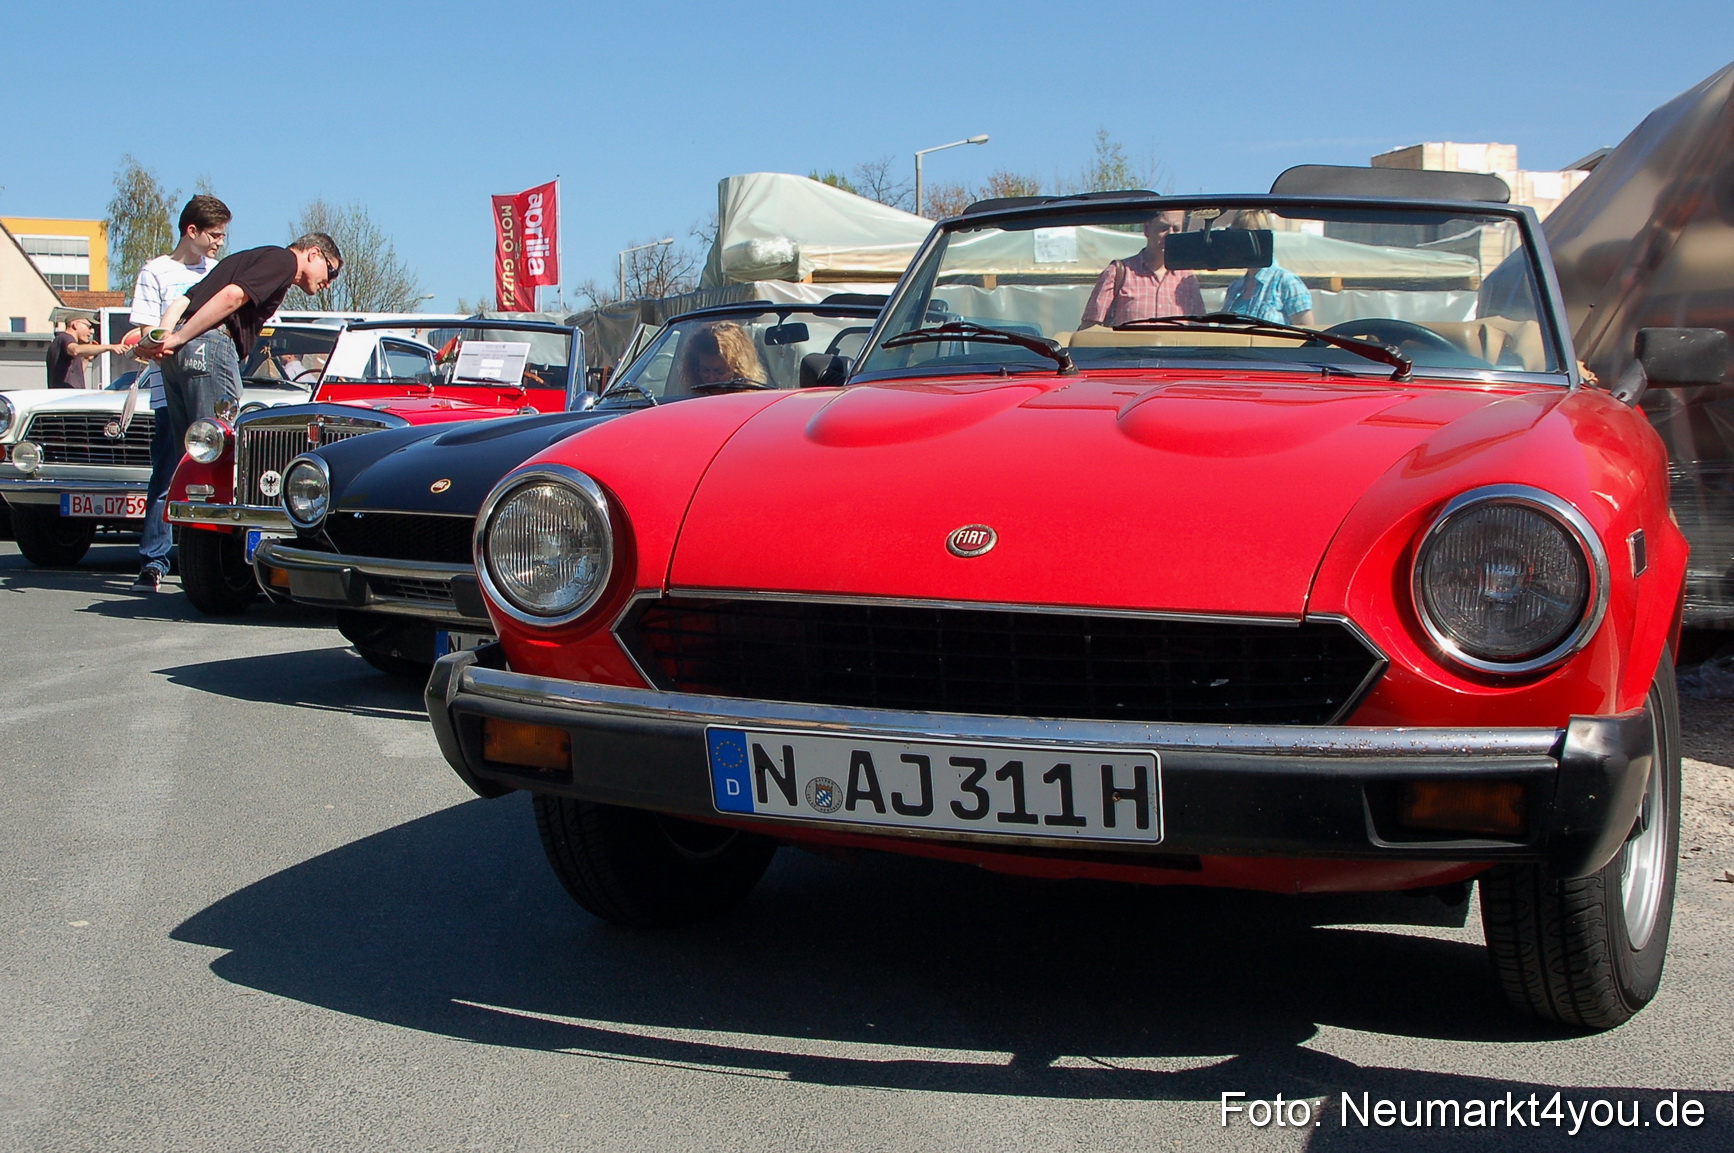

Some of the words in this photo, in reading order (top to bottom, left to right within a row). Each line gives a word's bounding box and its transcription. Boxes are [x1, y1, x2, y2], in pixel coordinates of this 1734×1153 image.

[501, 205, 514, 253] MOTO
[524, 192, 550, 276] aprilia
[502, 258, 515, 307] GUZZI
[194, 342, 206, 363] 4
[72, 496, 93, 514] BA
[955, 530, 988, 545] FIAT
[726, 778, 740, 796] D
